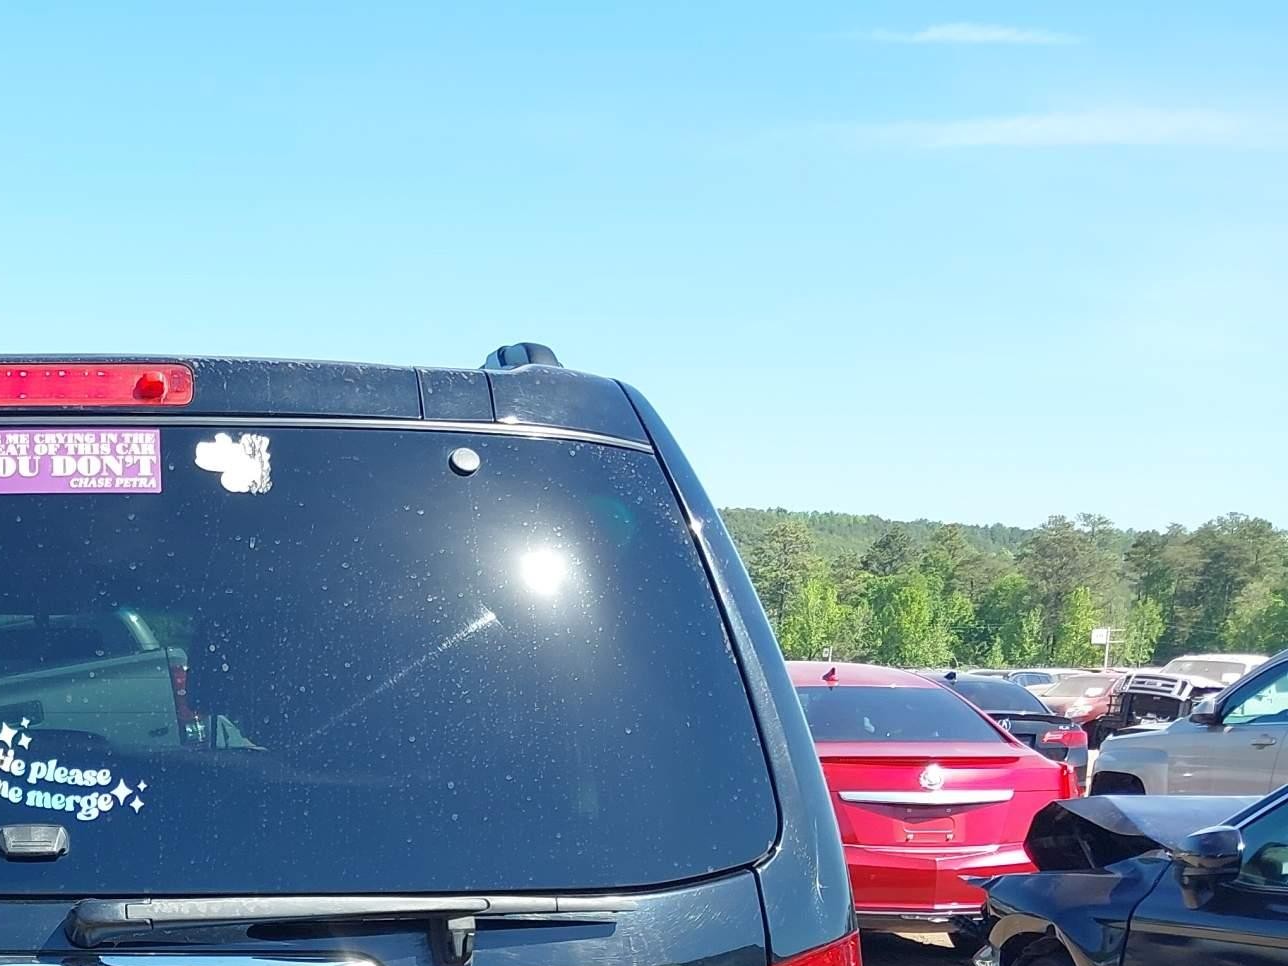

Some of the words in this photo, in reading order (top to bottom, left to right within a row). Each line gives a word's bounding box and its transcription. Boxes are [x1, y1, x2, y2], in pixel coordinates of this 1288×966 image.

[6, 433, 29, 444] ME
[33, 433, 95, 444] CRYING
[100, 432, 118, 443] IN
[122, 432, 155, 443] THE
[33, 443, 60, 456] OF
[64, 443, 111, 456] THIS
[115, 443, 155, 455] CAR
[51, 455, 157, 477] DON'T
[69, 477, 113, 488] CHASE
[114, 477, 157, 488] PETRA
[27, 759, 112, 787] please
[25, 790, 114, 821] merge
